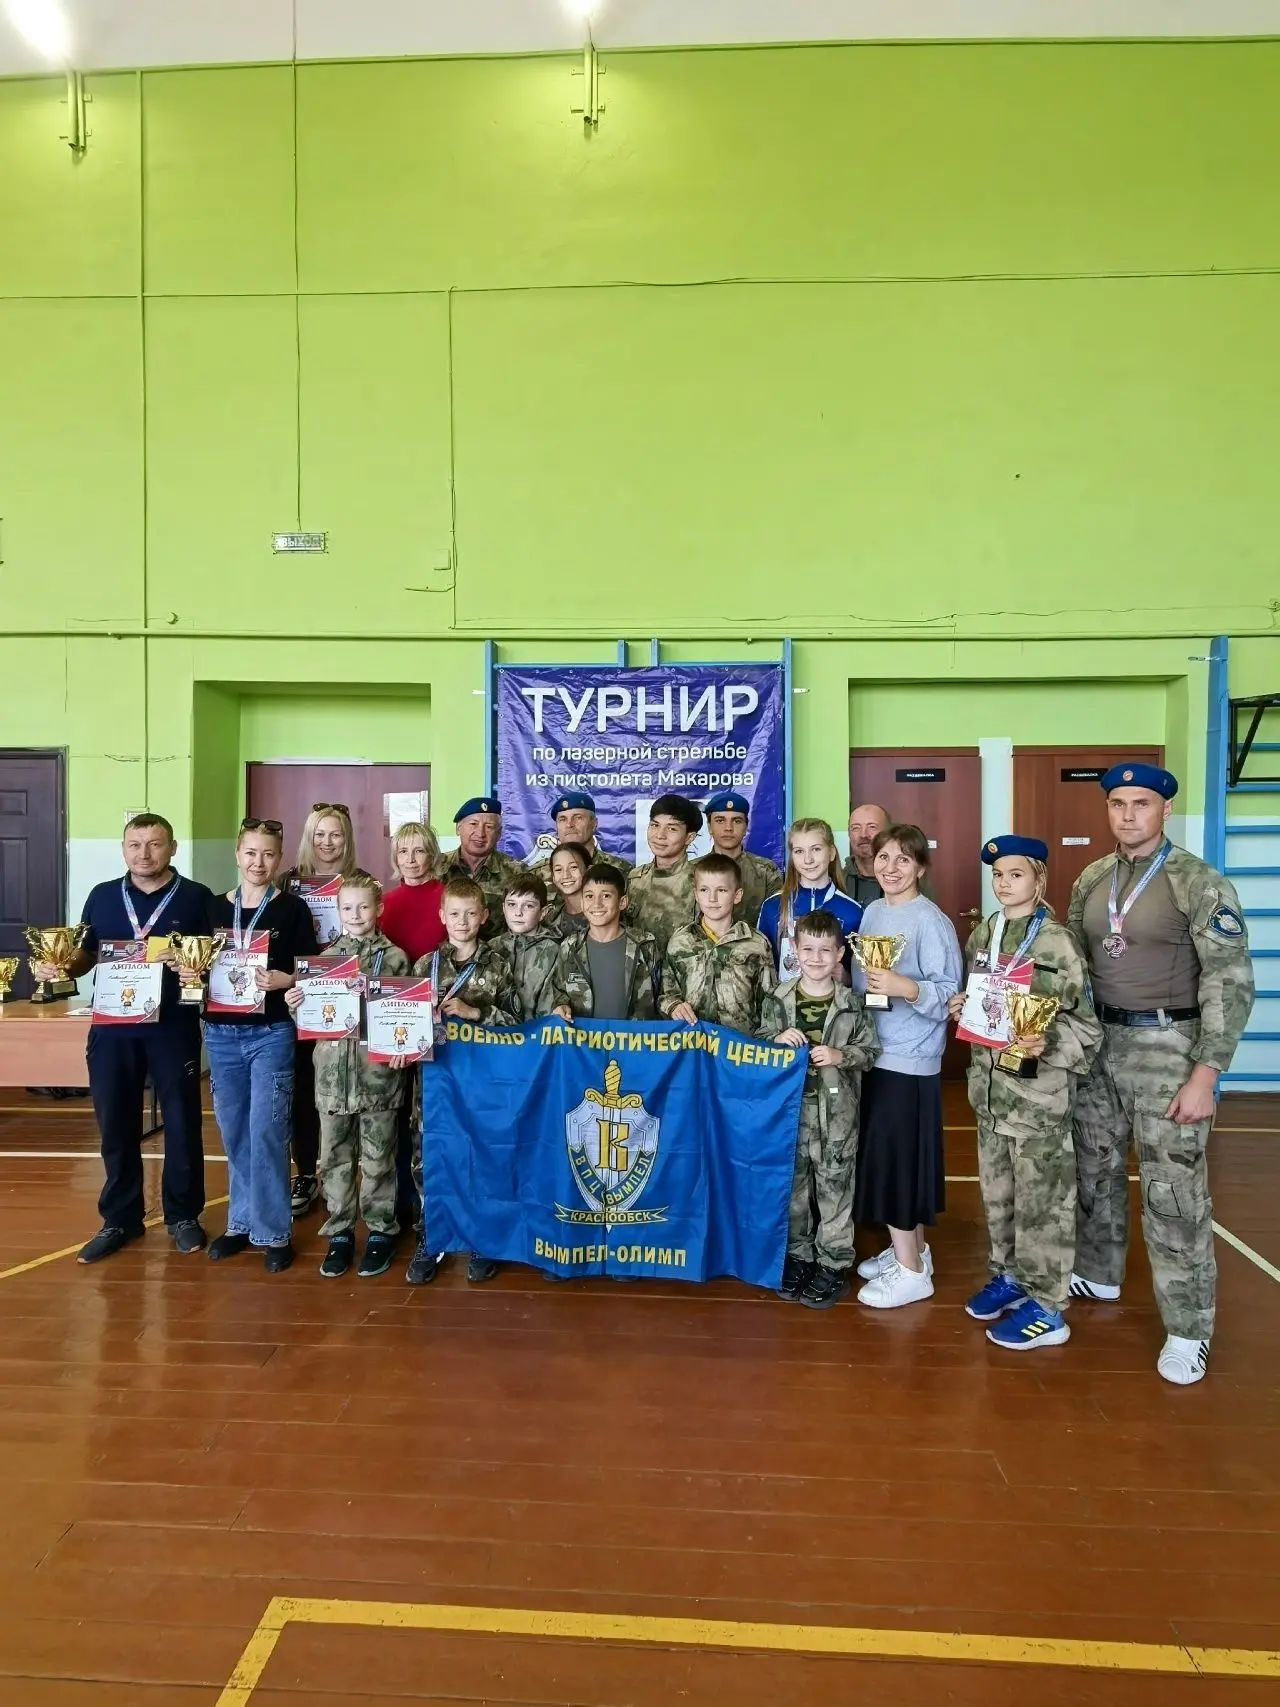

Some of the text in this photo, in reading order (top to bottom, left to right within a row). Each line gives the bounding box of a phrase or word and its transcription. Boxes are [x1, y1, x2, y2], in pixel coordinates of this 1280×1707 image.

[521, 685, 759, 733] ТУРНИР
[533, 742, 747, 764] по лазерной стрельбе
[526, 769, 754, 790] из пистолета Макарова
[309, 979, 347, 987] ДИПЛОМ
[726, 1040, 796, 1069] ЦЕНТР
[605, 1157, 651, 1205] ВЫМПЕЛ
[570, 1211, 652, 1223] КРАСНООБСК
[535, 1237, 687, 1267] ВЫМПЕЛ-ОЛИМП
